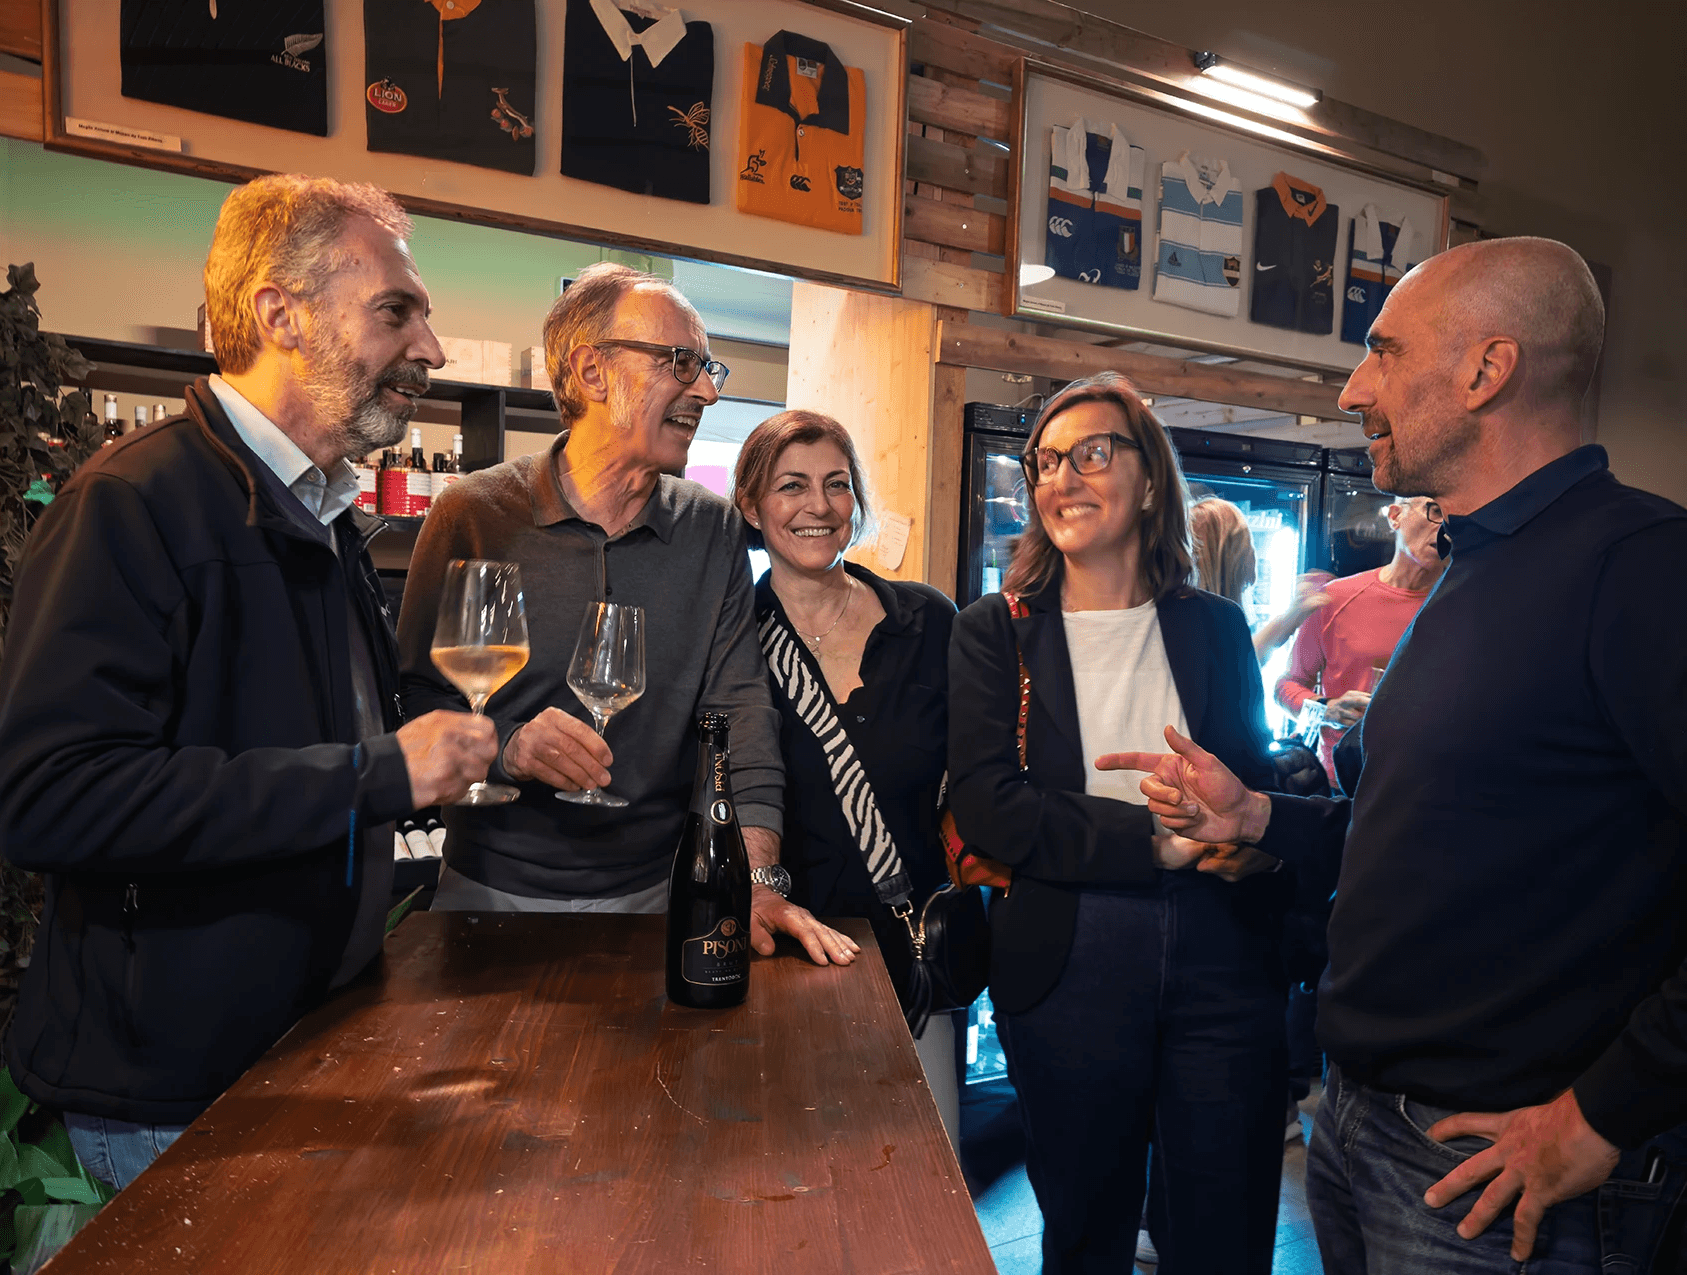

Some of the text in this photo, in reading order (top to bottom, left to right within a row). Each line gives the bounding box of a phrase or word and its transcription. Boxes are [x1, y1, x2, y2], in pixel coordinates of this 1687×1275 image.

[270, 54, 283, 65] ALL
[284, 58, 310, 72] BLACKS
[374, 87, 402, 102] LION
